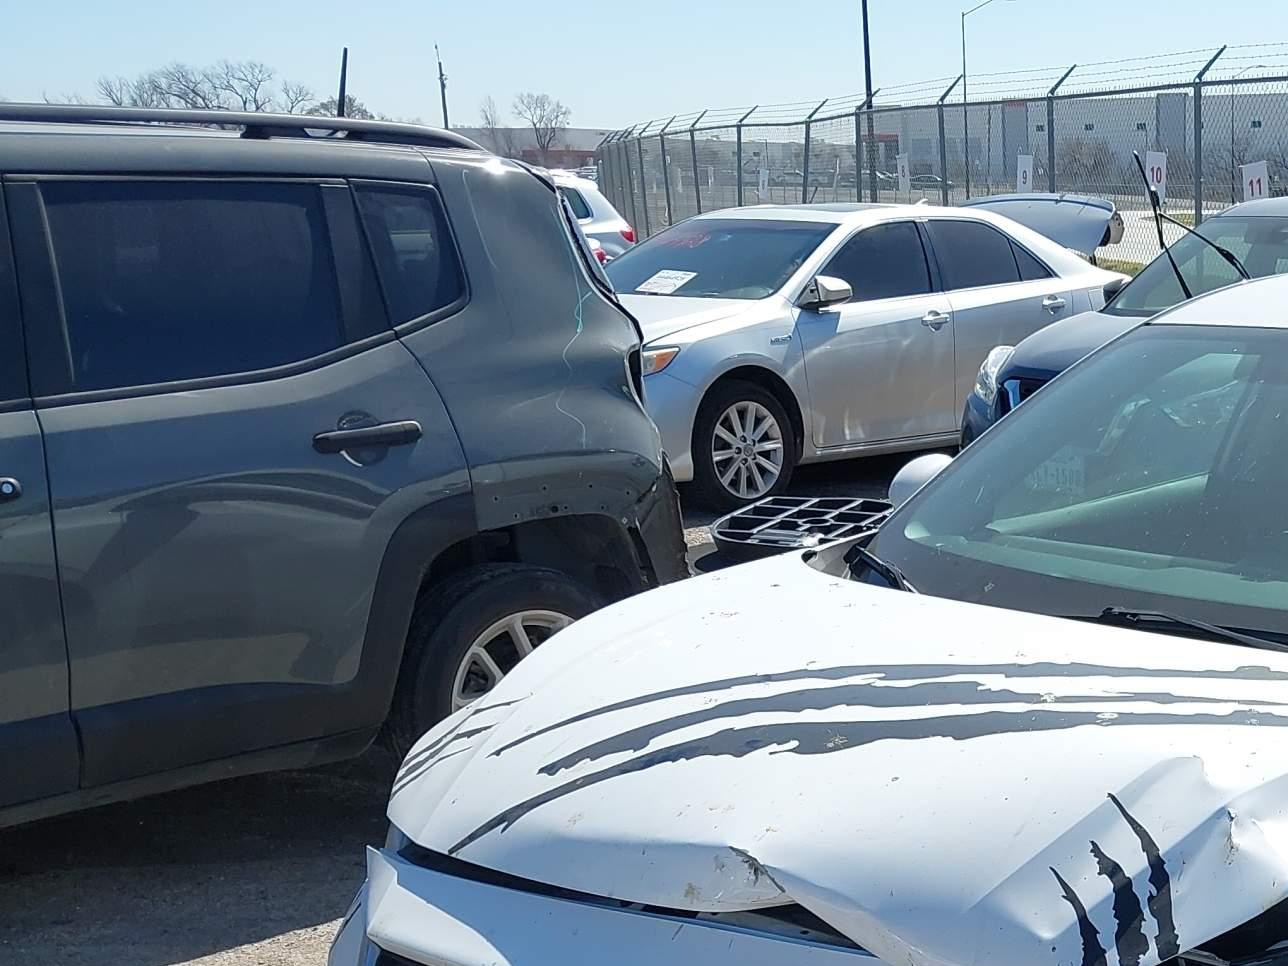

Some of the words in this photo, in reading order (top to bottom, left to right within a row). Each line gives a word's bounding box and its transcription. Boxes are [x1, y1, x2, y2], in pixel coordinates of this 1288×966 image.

[1022, 169, 1029, 185] 9
[1150, 166, 1162, 184] 10
[1249, 177, 1263, 196] 11
